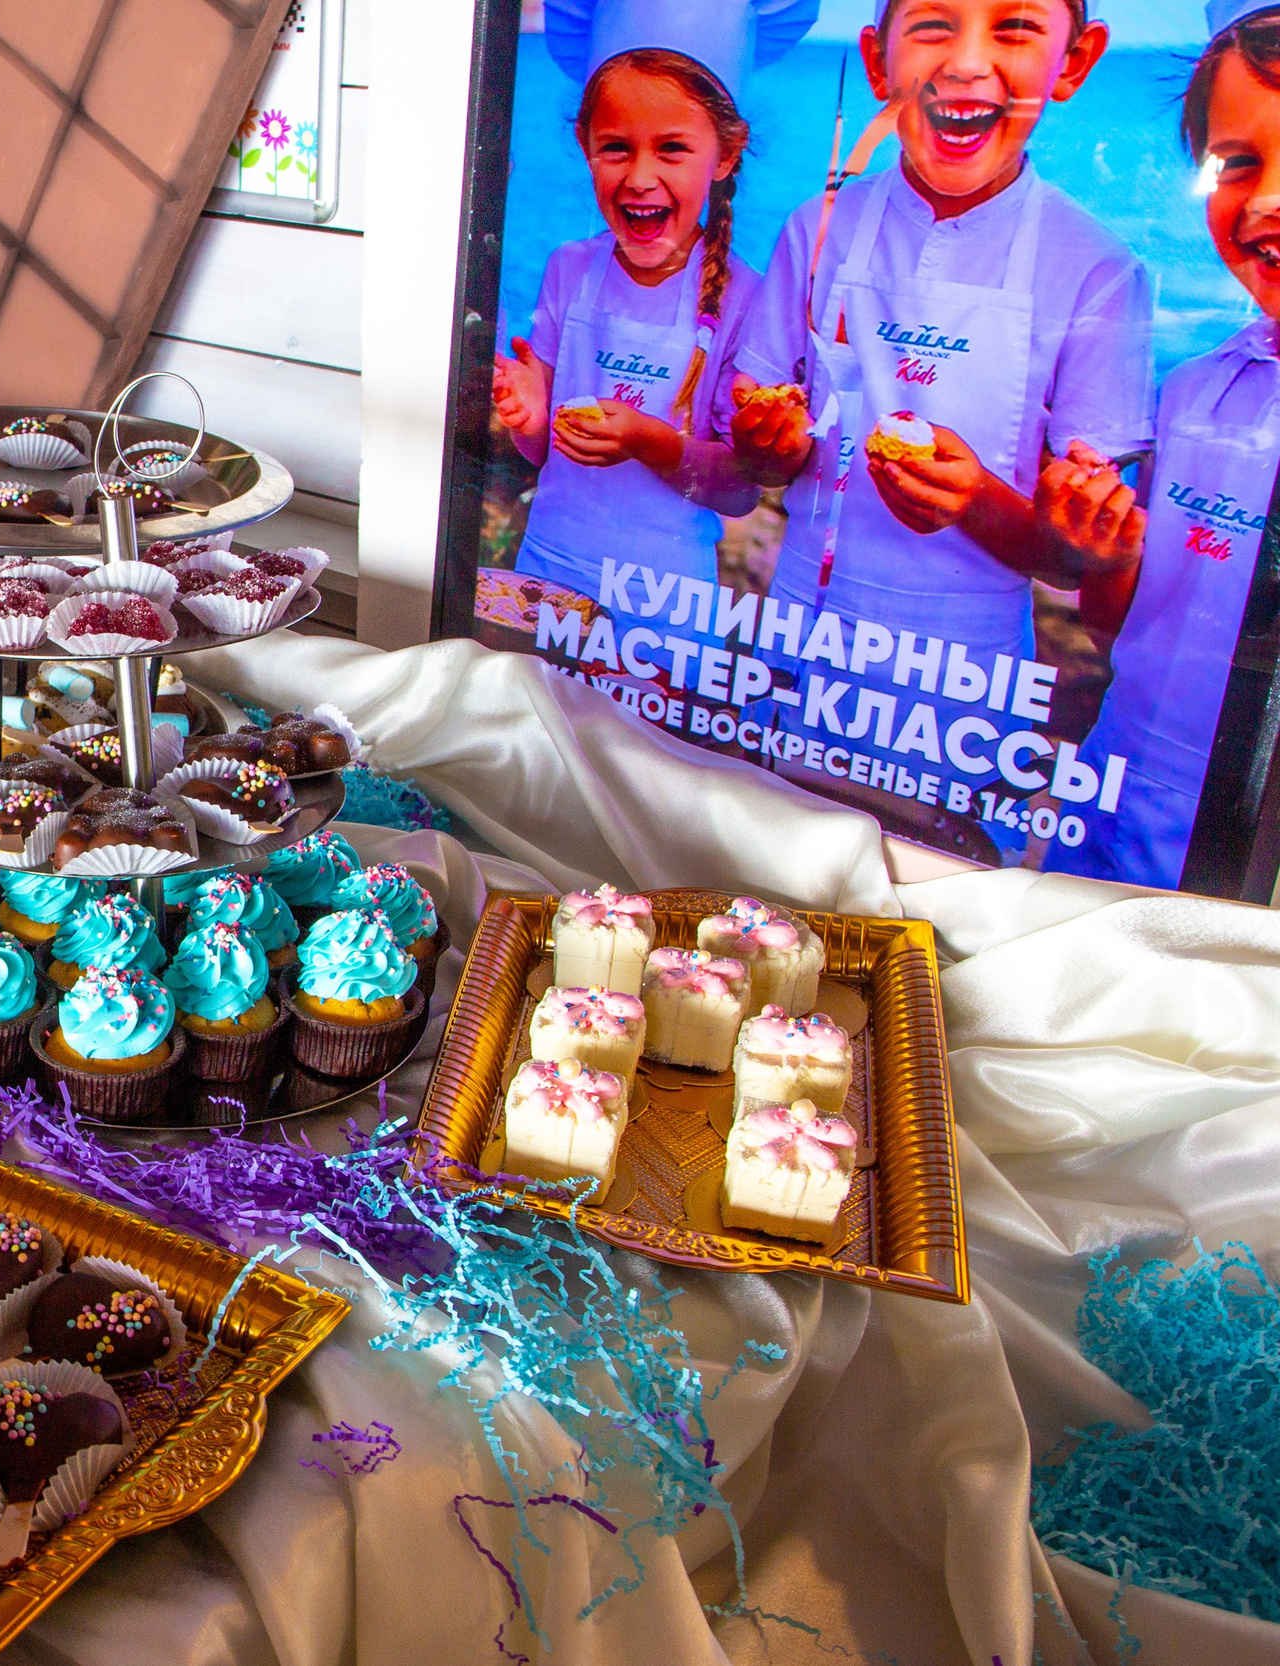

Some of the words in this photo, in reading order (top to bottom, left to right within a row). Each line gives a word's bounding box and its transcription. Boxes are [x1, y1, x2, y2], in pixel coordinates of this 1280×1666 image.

[876, 320, 970, 353] Чайка
[595, 349, 671, 380] Чайка
[895, 357, 938, 386] Kids
[612, 382, 647, 409] Kids
[1184, 525, 1233, 562] Kids
[597, 556, 1059, 724] КУЛИНАРНЫЕ
[535, 600, 1128, 815] МАСТЕР-КЛАССЫ
[689, 704, 942, 807] ВОСКРЕСЕНЬЕ
[944, 780, 973, 815] В
[979, 790, 1087, 848] 14:00
